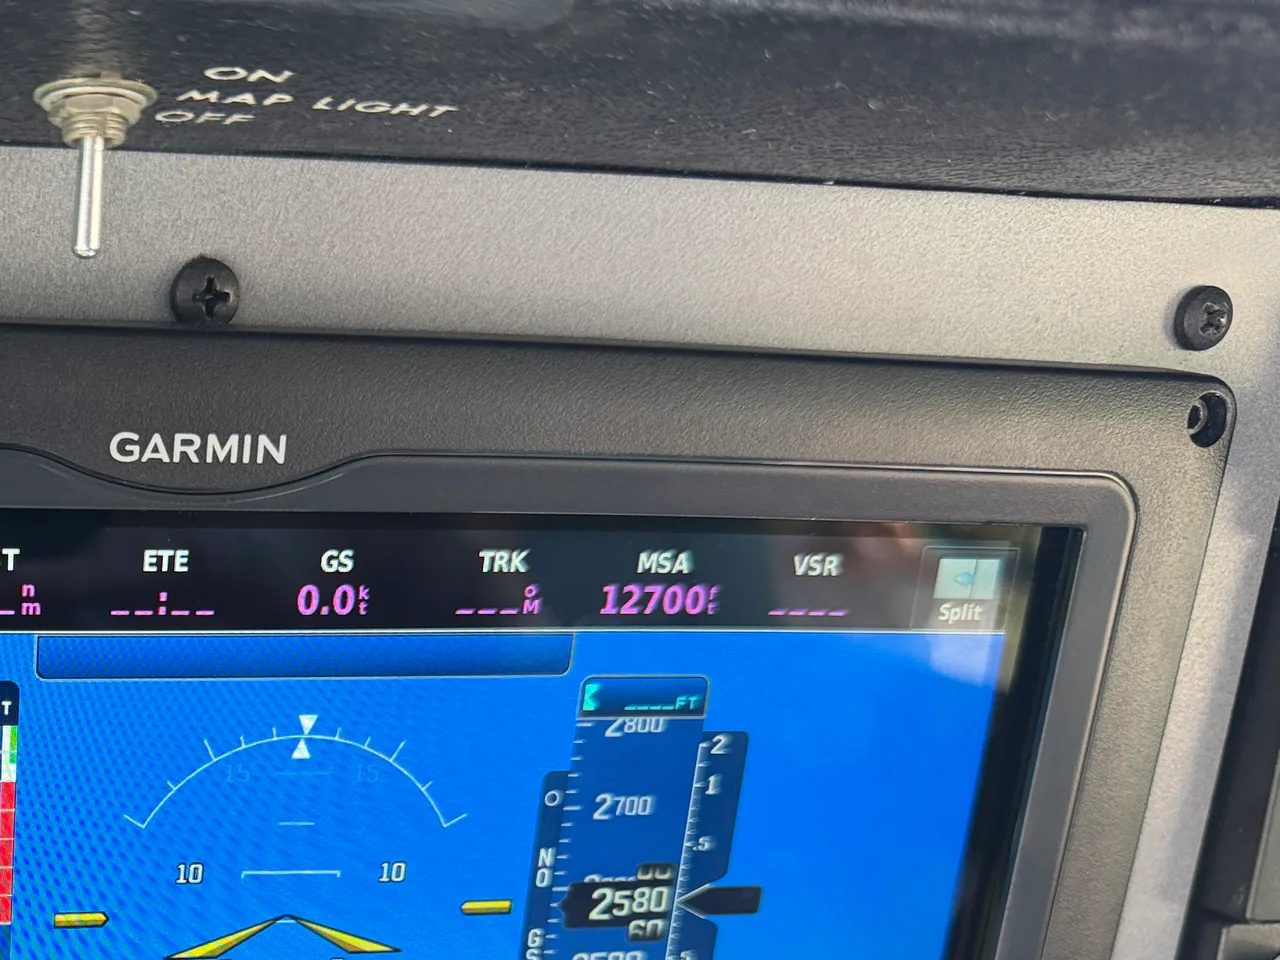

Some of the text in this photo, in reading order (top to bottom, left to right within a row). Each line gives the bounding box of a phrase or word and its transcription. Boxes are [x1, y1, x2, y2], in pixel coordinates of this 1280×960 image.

[203, 66, 296, 84] ON
[176, 89, 459, 118] MAP LIGHT
[155, 109, 256, 125] OFF
[110, 432, 287, 464] GARMIN
[142, 549, 189, 573] ETE
[320, 549, 355, 573] GS
[479, 549, 531, 573] TRK
[637, 550, 694, 575] MSA
[792, 552, 844, 578] VSR
[937, 602, 984, 625] Split
[605, 717, 665, 737] 2800
[710, 735, 732, 755] 2
[705, 774, 721, 795] 1
[593, 793, 654, 820] 2700
[176, 863, 203, 884] 10
[378, 862, 406, 882] 10
[589, 886, 670, 920] 2580
